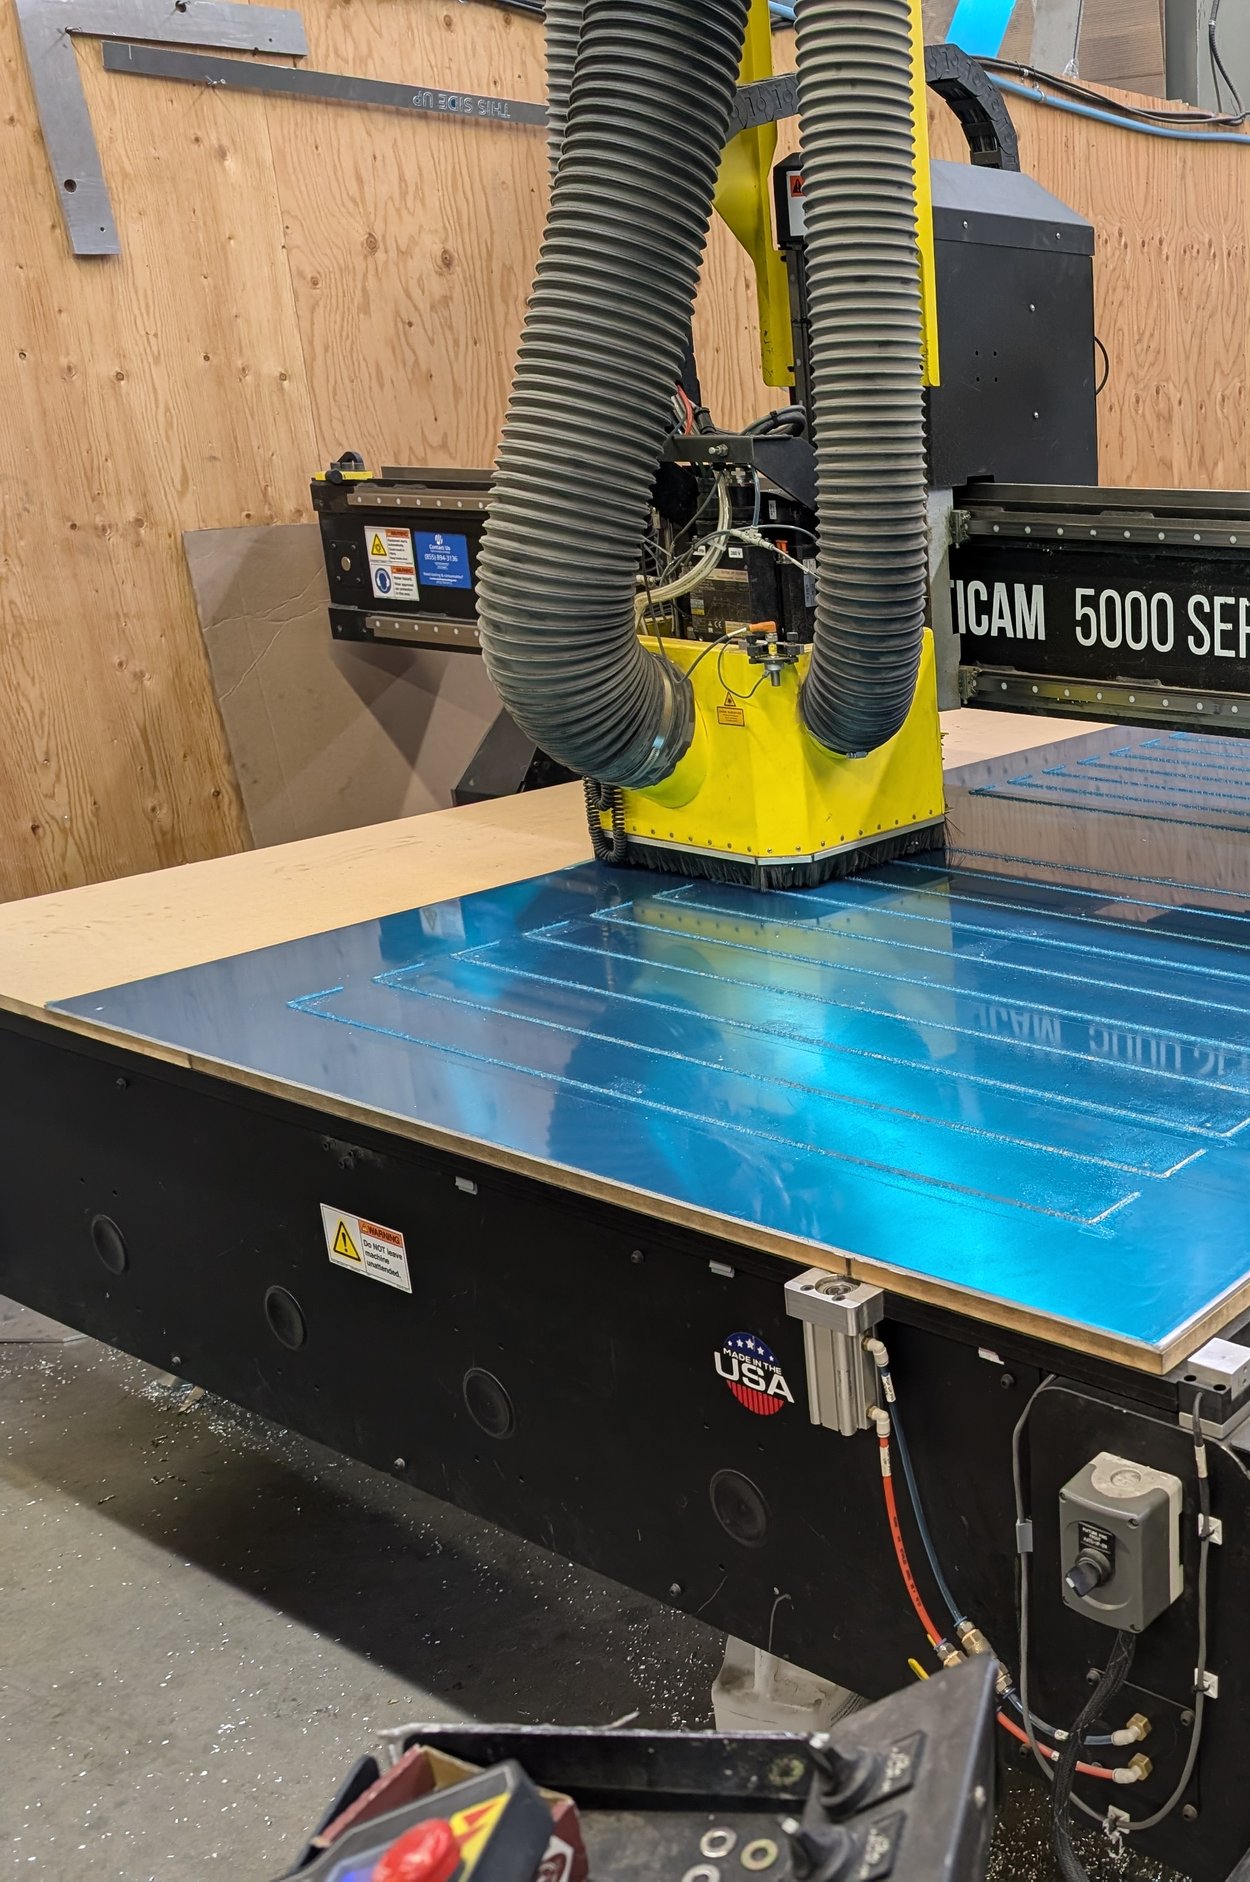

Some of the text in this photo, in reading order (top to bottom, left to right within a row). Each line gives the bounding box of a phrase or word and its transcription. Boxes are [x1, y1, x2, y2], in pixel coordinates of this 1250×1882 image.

[412, 91, 511, 118] THIS SIDE UP
[949, 579, 1046, 641] ICAM
[1075, 587, 1174, 652] 5000
[368, 1226, 400, 1245] WARNING
[363, 1239, 403, 1260] Do NOT leave
[365, 1250, 390, 1265] machine
[366, 1260, 401, 1279] unattended.
[723, 1347, 782, 1375] MADE IN THE
[713, 1351, 795, 1404] USA
